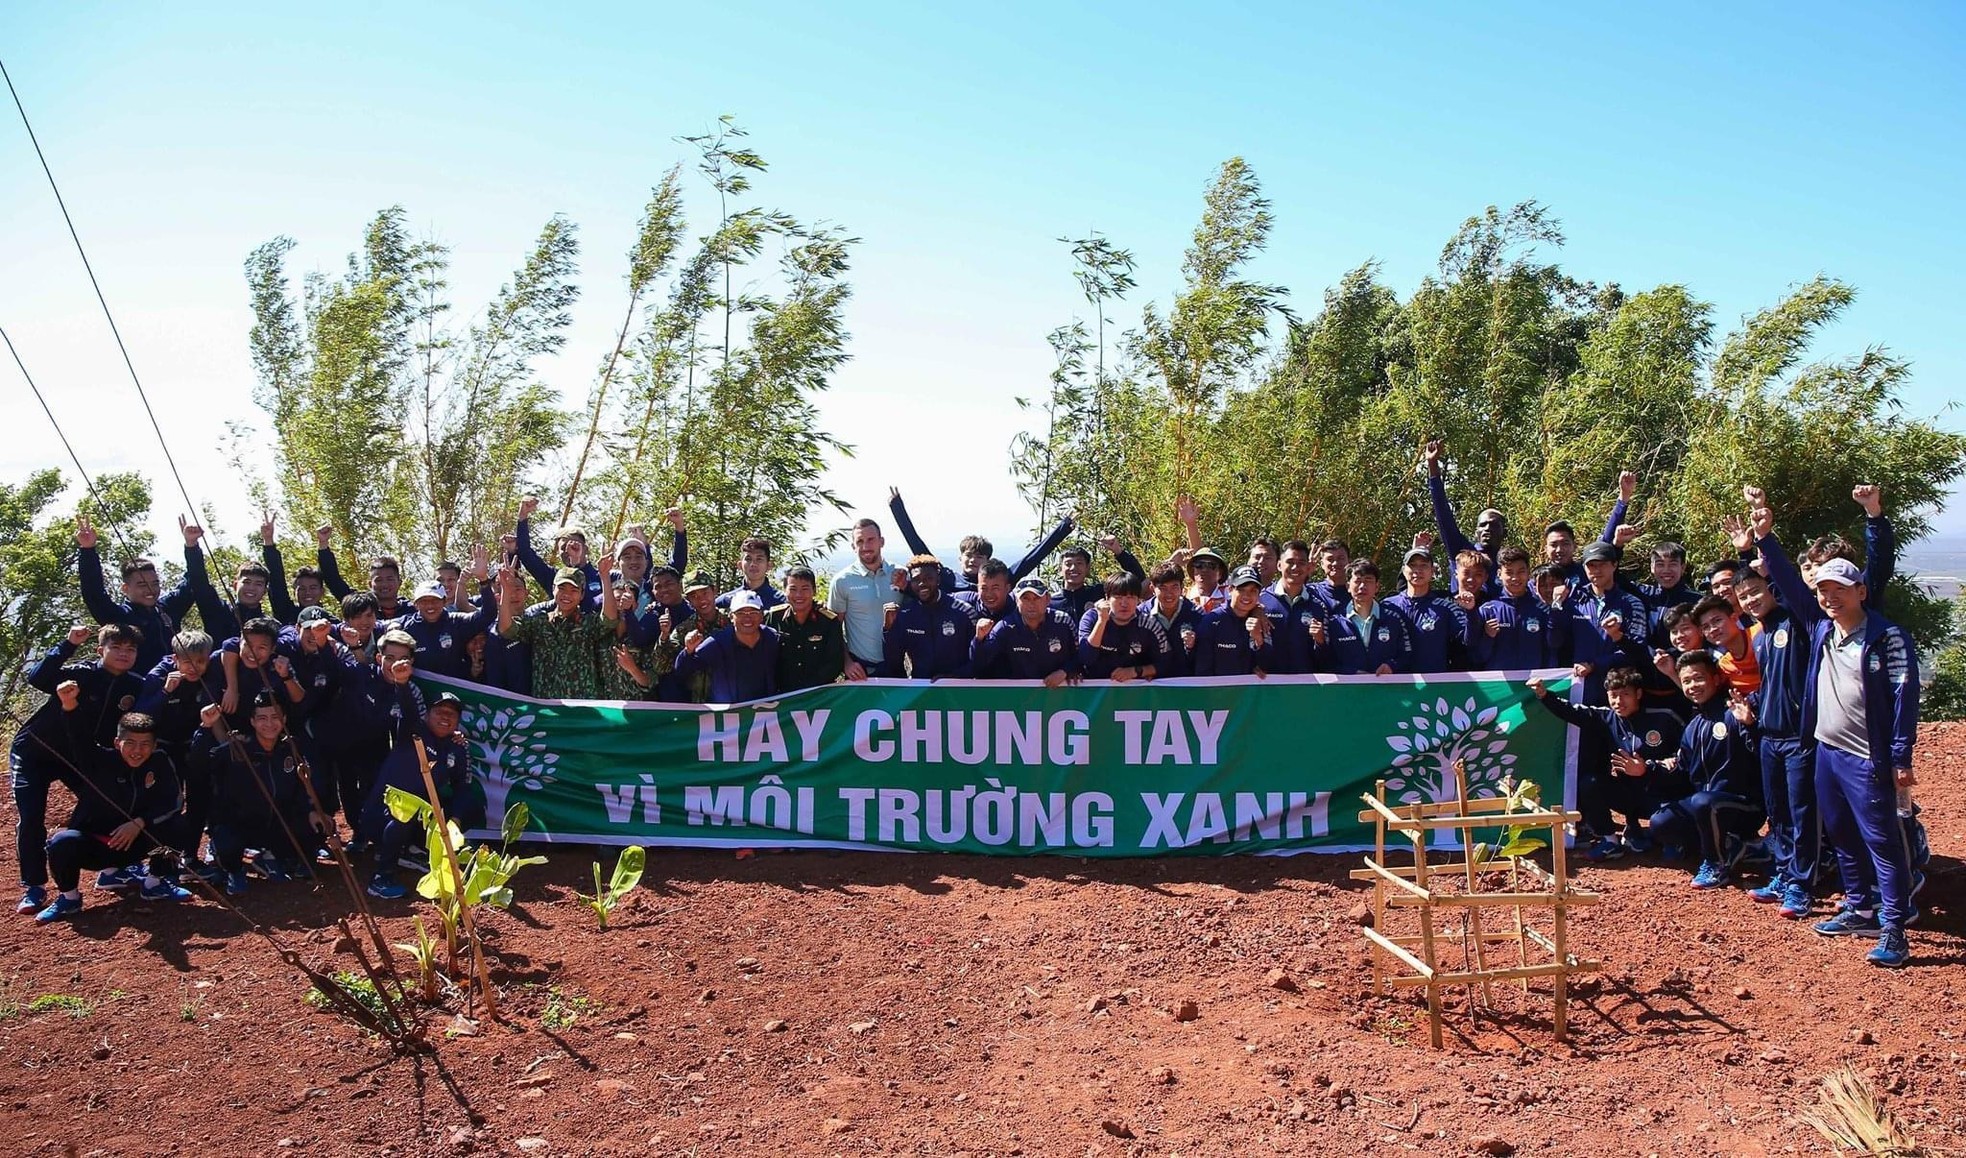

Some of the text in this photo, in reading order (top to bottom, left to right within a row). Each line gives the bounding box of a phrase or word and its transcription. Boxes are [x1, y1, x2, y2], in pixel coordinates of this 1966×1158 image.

[697, 701, 1230, 765] HÃY CHUNG TAY
[595, 774, 1332, 848] VÌ MÔI TRƯỜNG XANH
